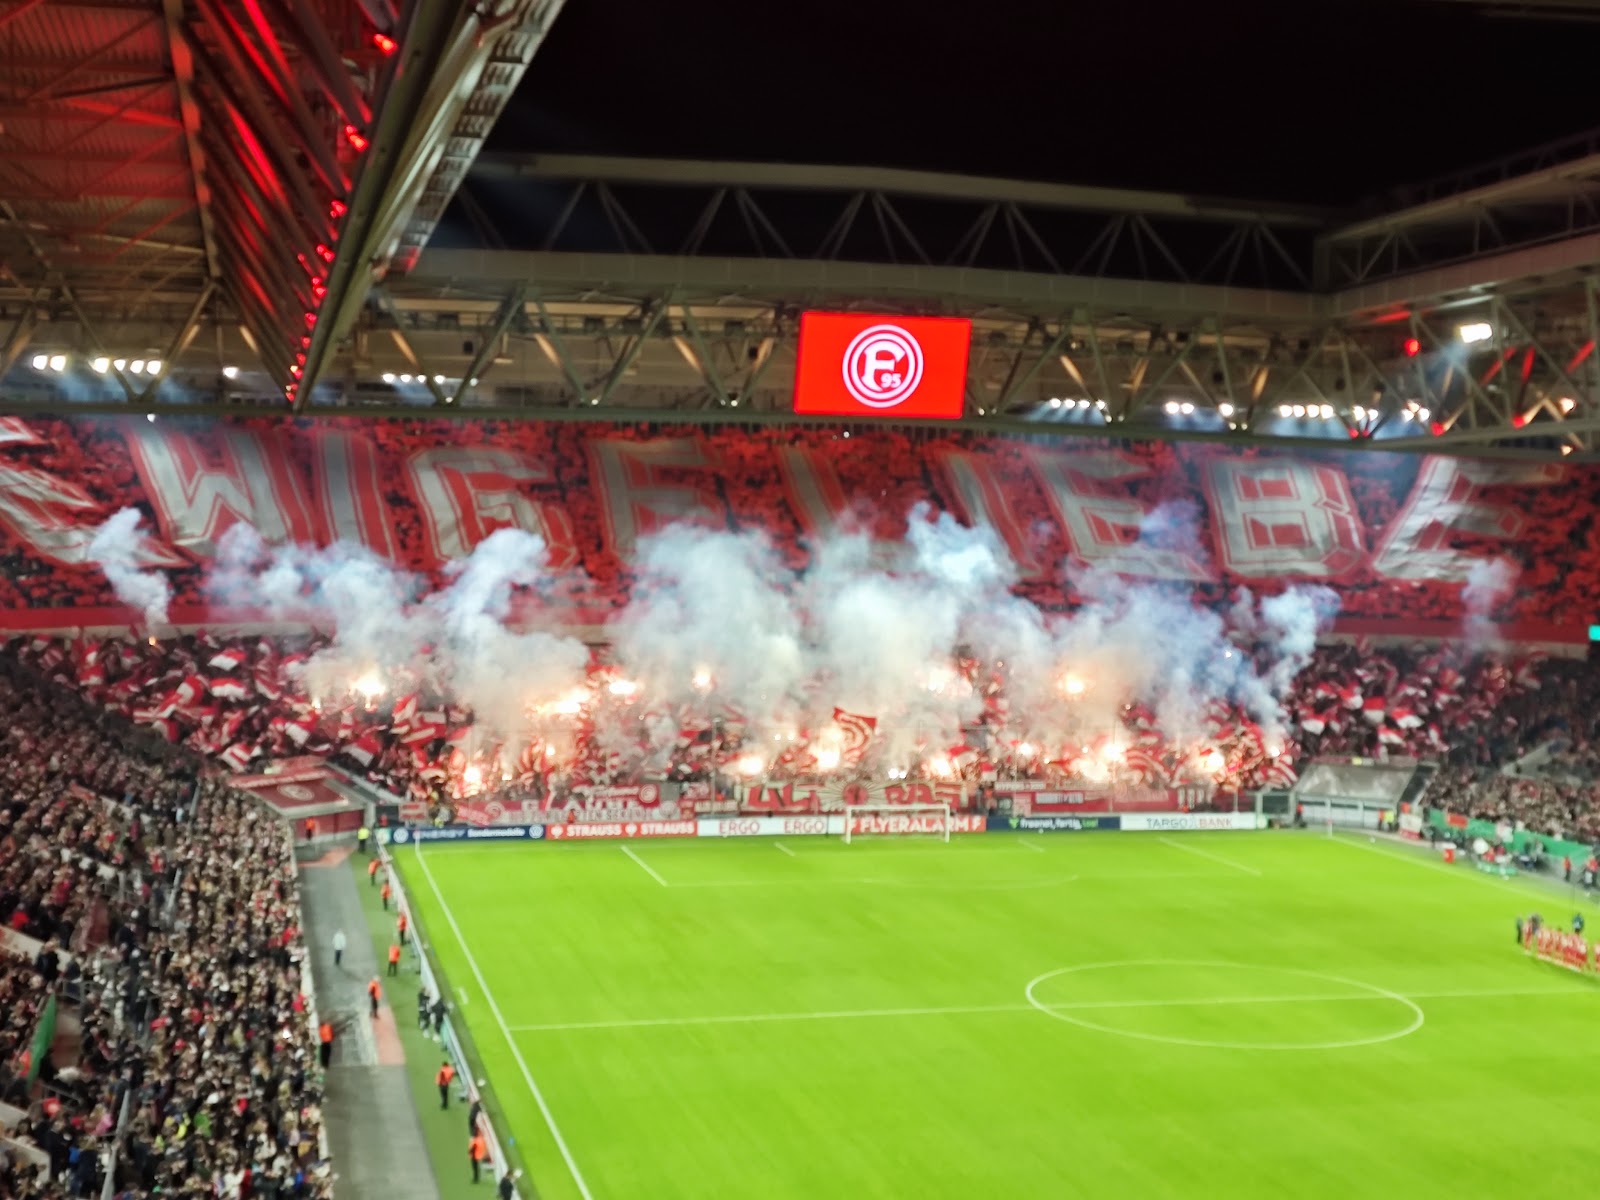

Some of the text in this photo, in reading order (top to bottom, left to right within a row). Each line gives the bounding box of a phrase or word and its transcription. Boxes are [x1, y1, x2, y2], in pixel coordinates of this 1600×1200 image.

[880, 373, 902, 388] 95
[566, 823, 695, 837] STRAUSS STRAUSS
[719, 819, 825, 834] ERGO ERGO
[859, 816, 969, 832] FLYERALARM
